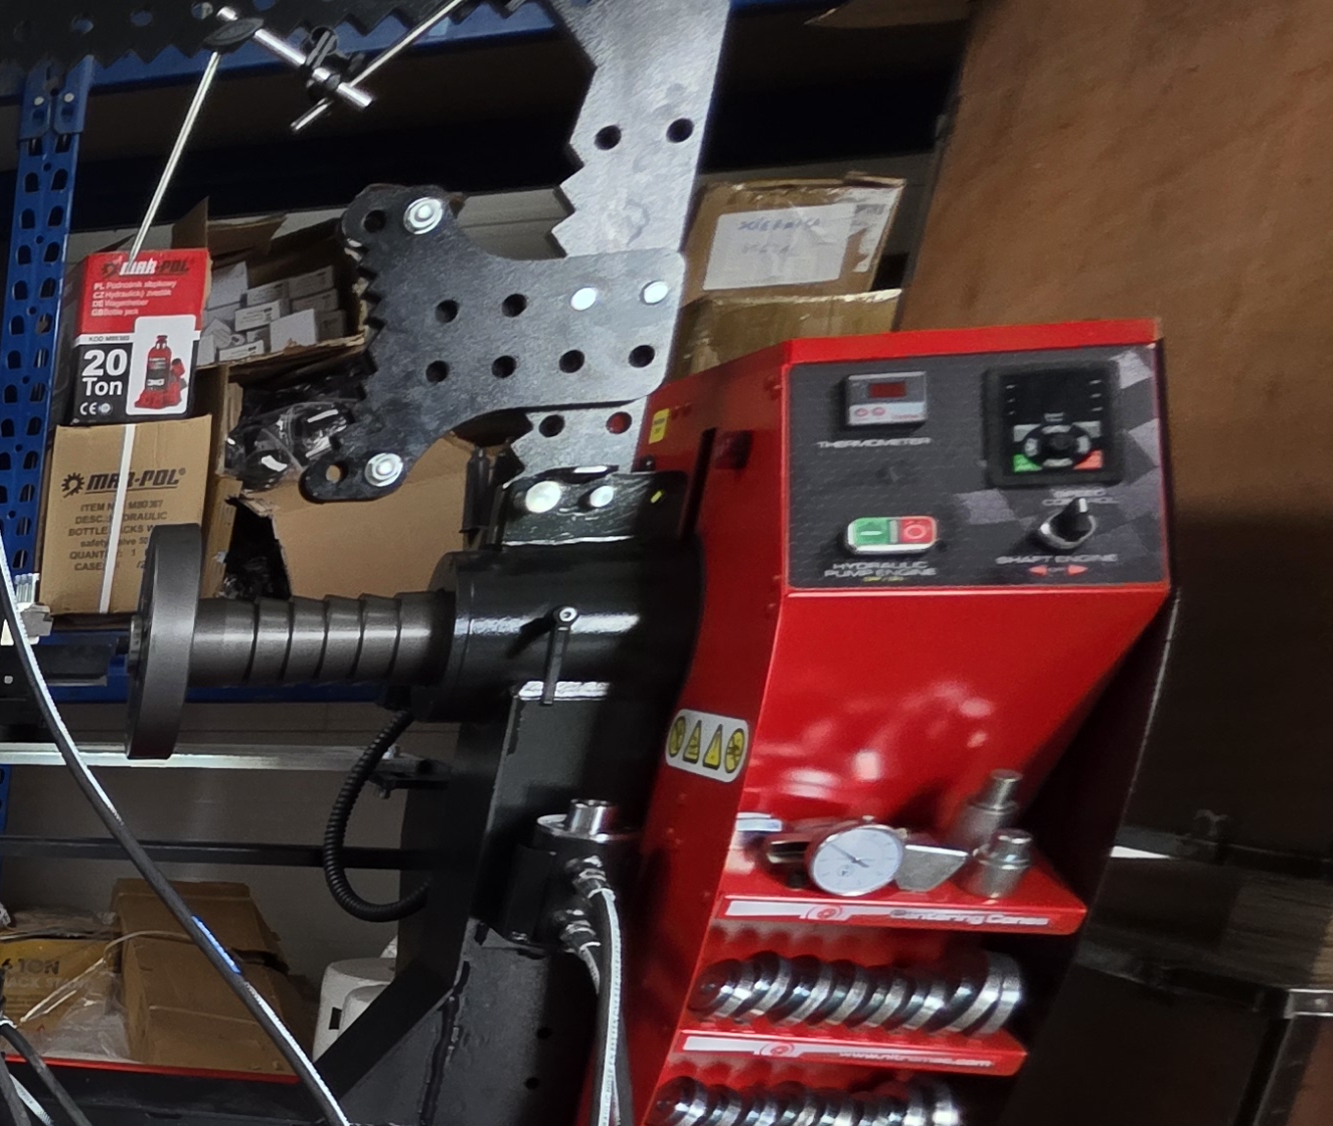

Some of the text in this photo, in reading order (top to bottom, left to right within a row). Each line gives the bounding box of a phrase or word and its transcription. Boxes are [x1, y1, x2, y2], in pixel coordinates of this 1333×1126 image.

[93, 282, 104, 290] PL
[93, 291, 104, 299] CZ
[82, 349, 128, 376] 20
[82, 377, 123, 396] Ton
[817, 436, 932, 449] THERMOMETER
[80, 503, 105, 512] ITEM
[68, 527, 107, 537] BOTTLE
[995, 554, 1118, 564] SHAFT ENGINE
[833, 560, 929, 570] HYDRAULIC
[824, 567, 936, 578] PUMP ENGINE
